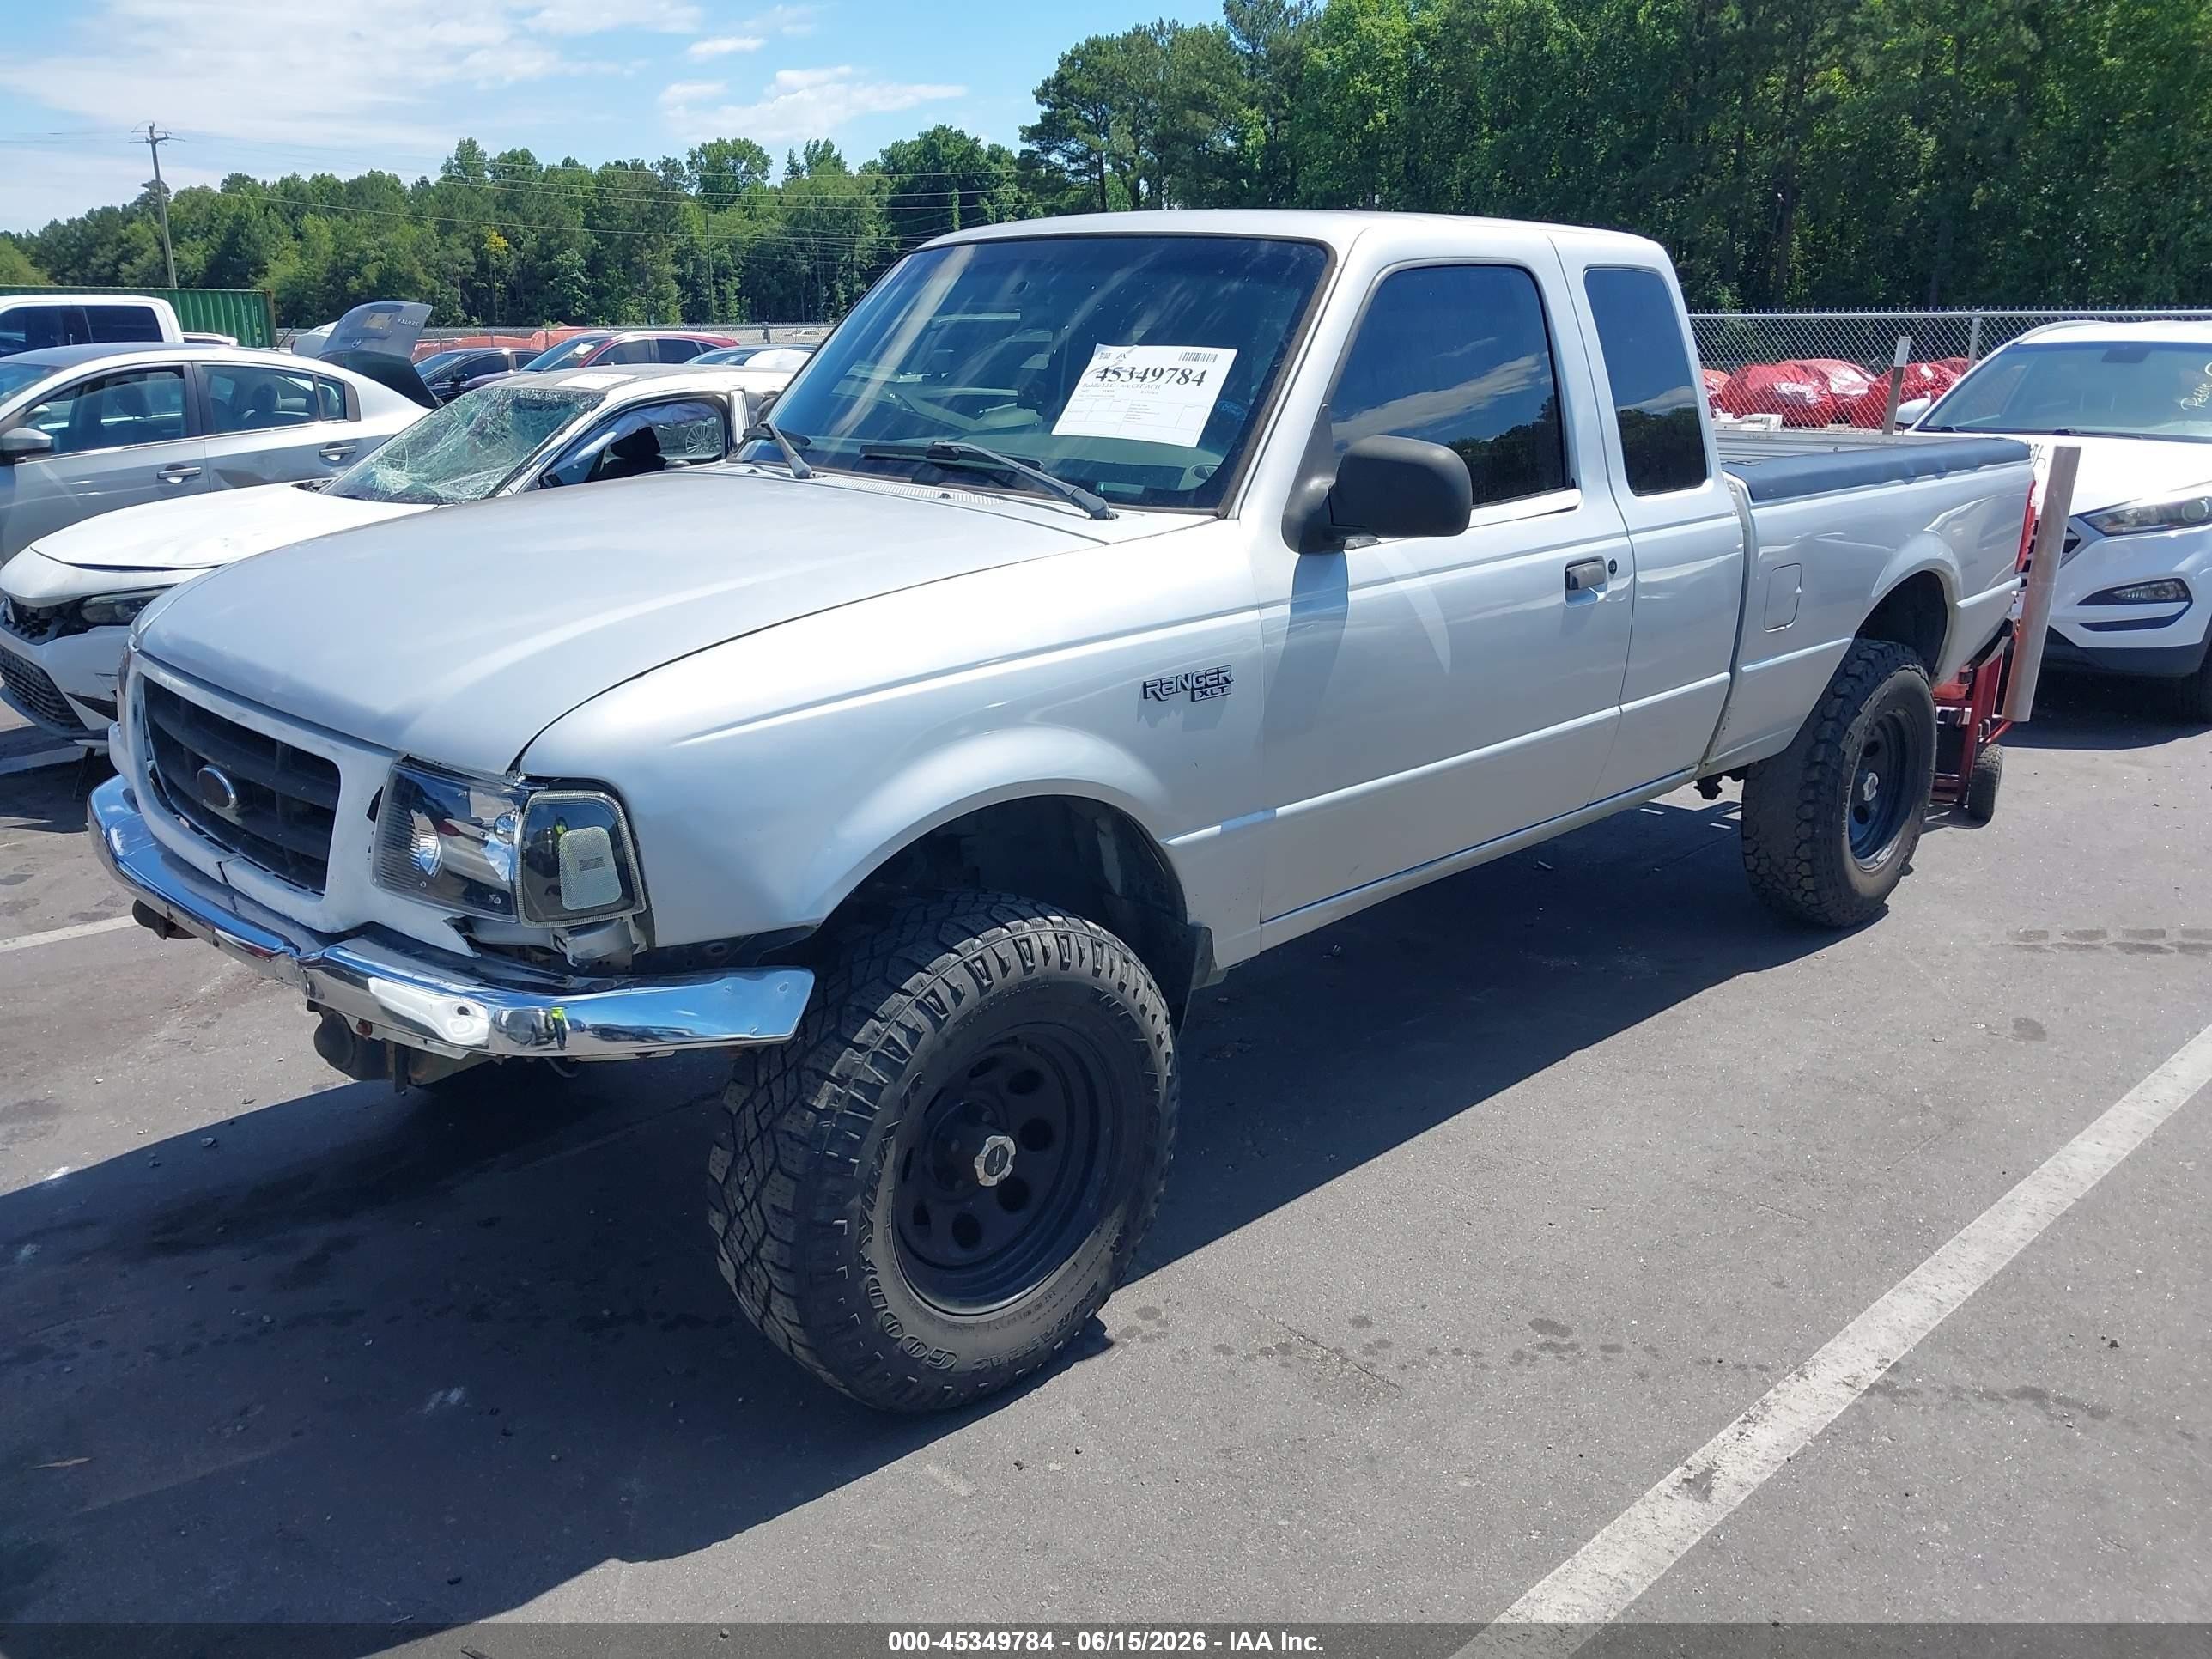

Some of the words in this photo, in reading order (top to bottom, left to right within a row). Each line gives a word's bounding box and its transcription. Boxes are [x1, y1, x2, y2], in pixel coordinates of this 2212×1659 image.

[1095, 366, 1207, 386] 45349784
[1143, 665, 1235, 702] RANGER
[1199, 686, 1226, 697] XLT
